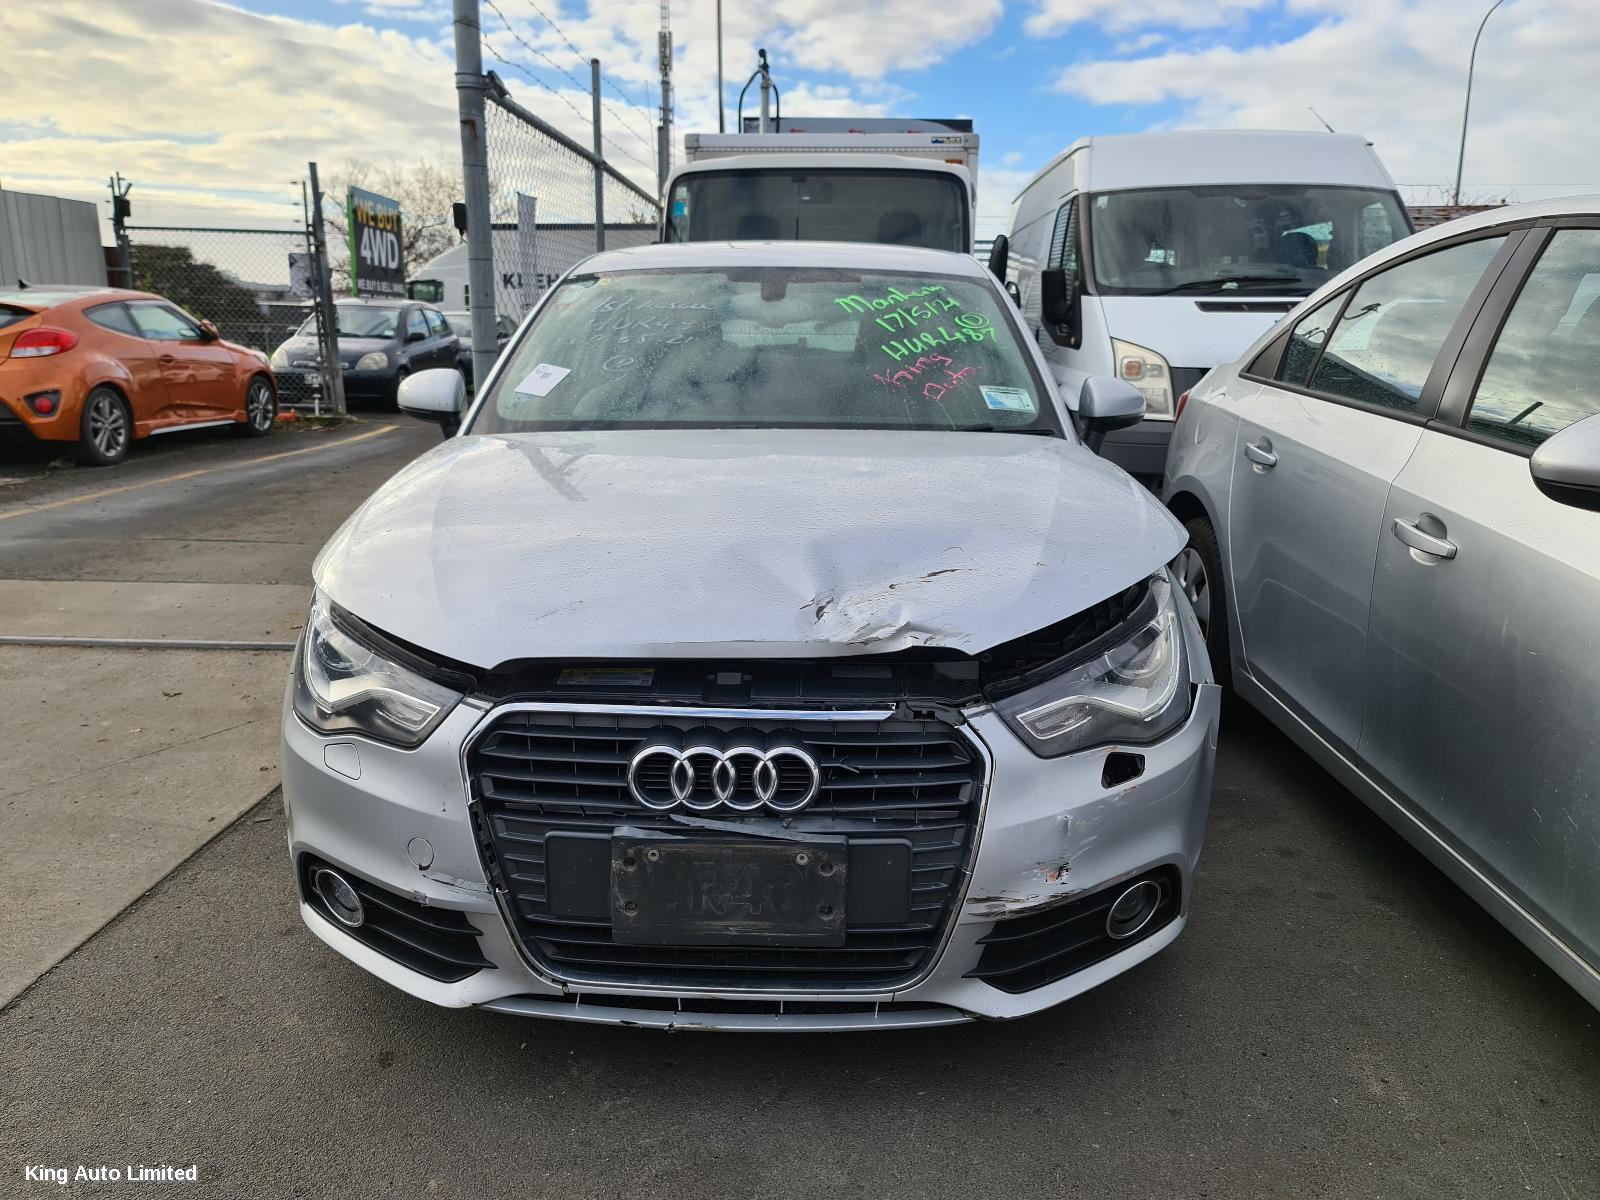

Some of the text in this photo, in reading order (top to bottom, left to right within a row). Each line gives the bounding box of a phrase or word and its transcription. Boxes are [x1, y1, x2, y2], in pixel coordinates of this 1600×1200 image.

[355, 197, 398, 233] WE BUY
[360, 226, 399, 270] 4WD
